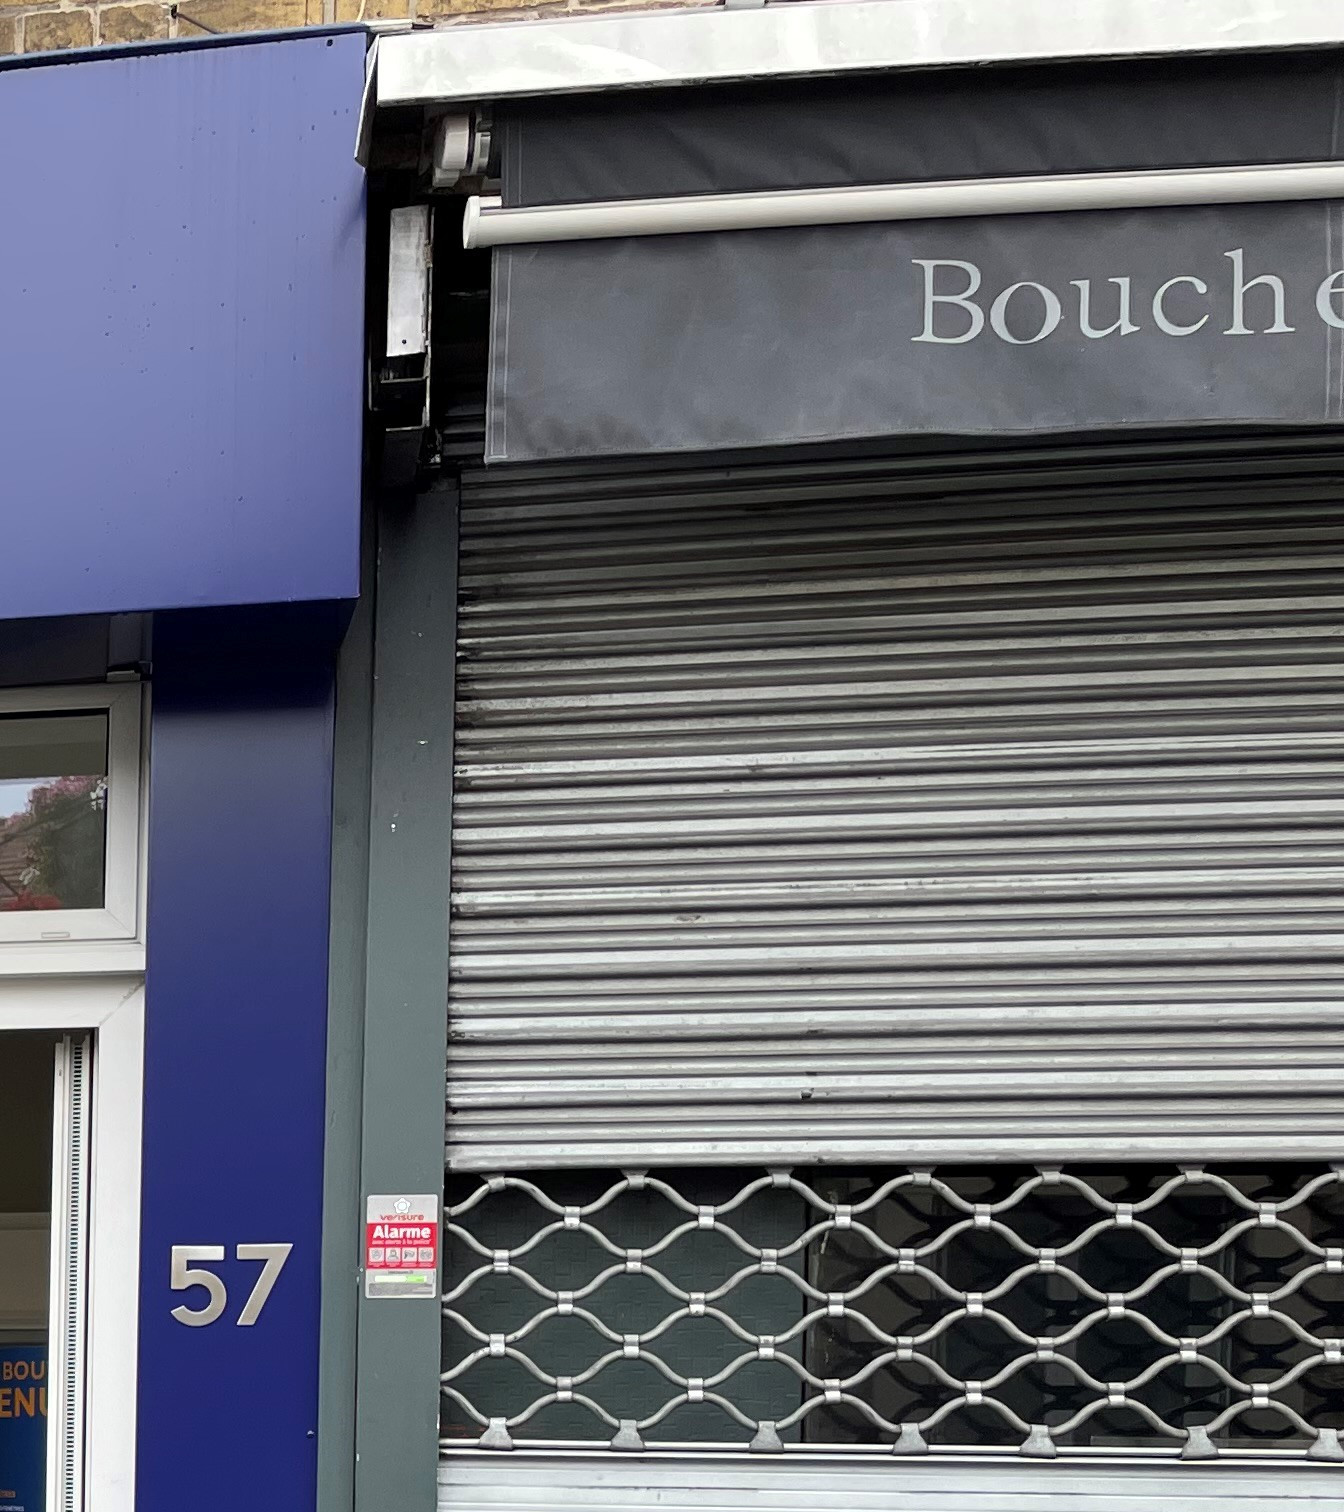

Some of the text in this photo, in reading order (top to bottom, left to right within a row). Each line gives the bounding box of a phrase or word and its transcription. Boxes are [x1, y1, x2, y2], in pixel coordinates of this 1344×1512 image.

[372, 1224, 432, 1239] Alarme
[170, 1243, 294, 1327] 57
[2, 1360, 46, 1380] BOU
